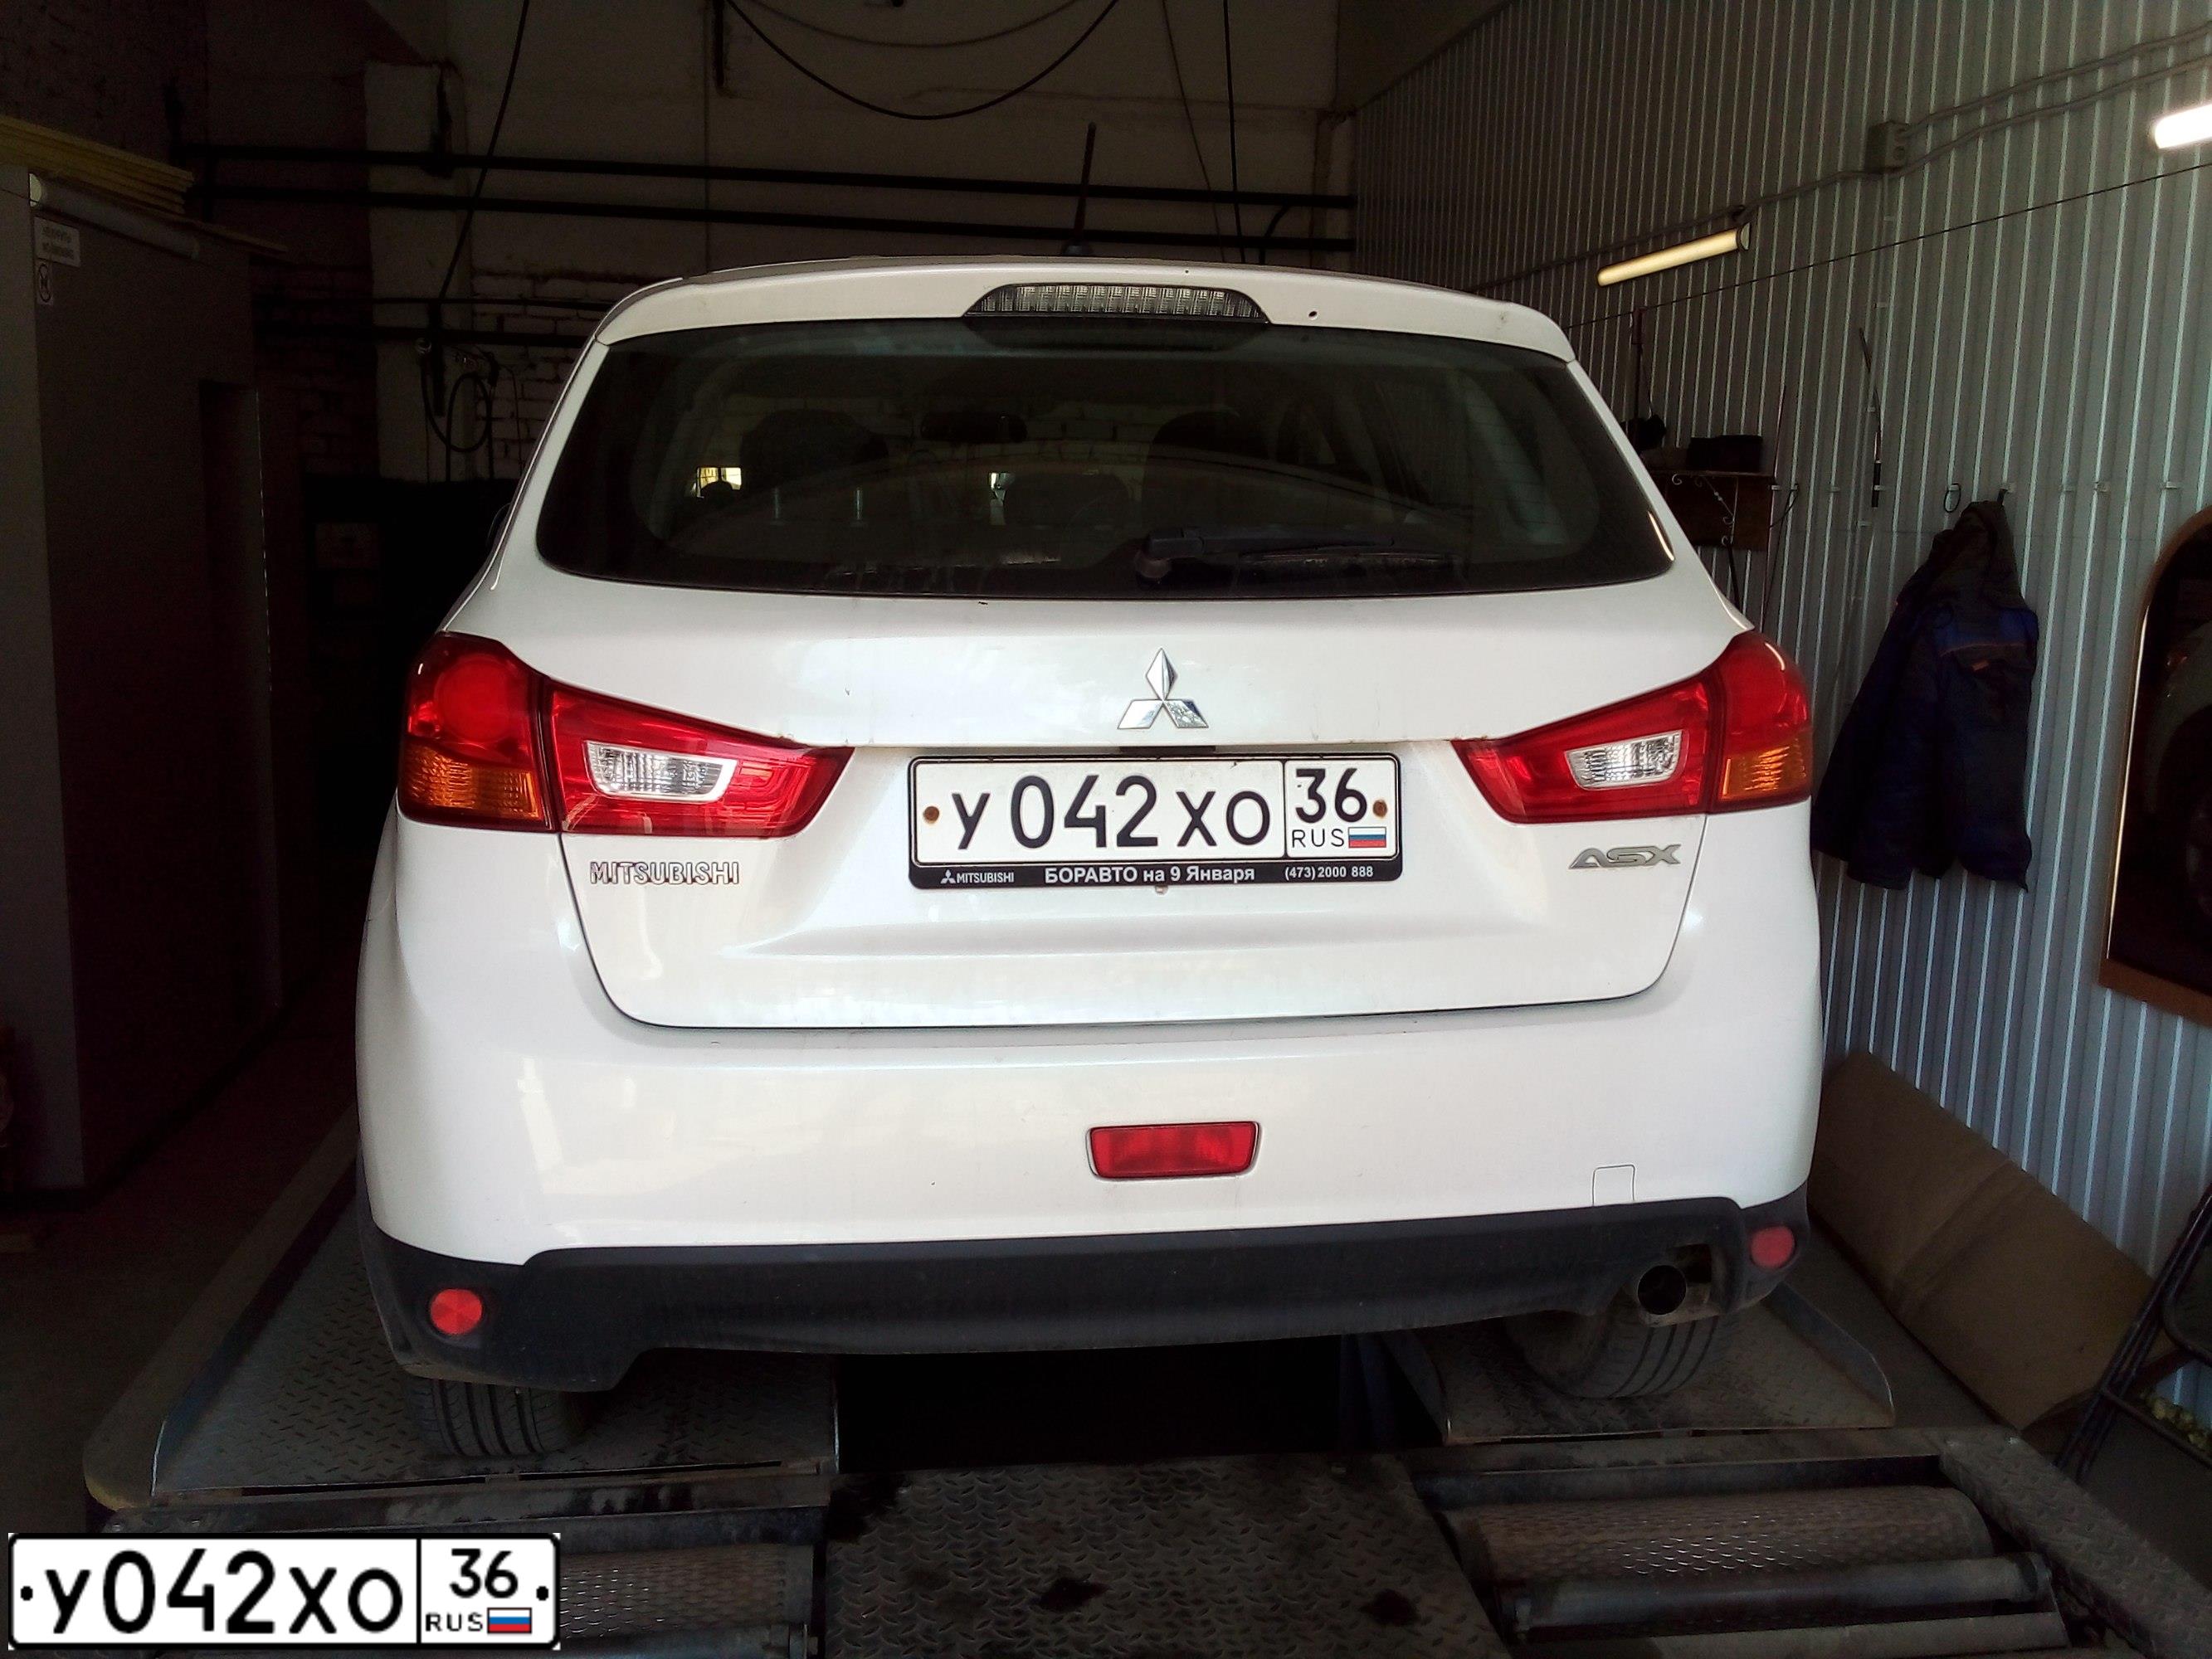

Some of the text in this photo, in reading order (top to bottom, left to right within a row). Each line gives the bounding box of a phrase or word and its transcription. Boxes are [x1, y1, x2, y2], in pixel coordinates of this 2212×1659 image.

[1294, 767, 1368, 824] 36
[1291, 828, 1345, 849] RUS
[1568, 844, 1682, 869] ASX
[590, 861, 740, 885] MITSUBISHI
[957, 872, 1015, 884] MITSUBISHI
[1045, 865, 1255, 884] БОРАВТО на 9 Января
[1351, 865, 1374, 878] 888
